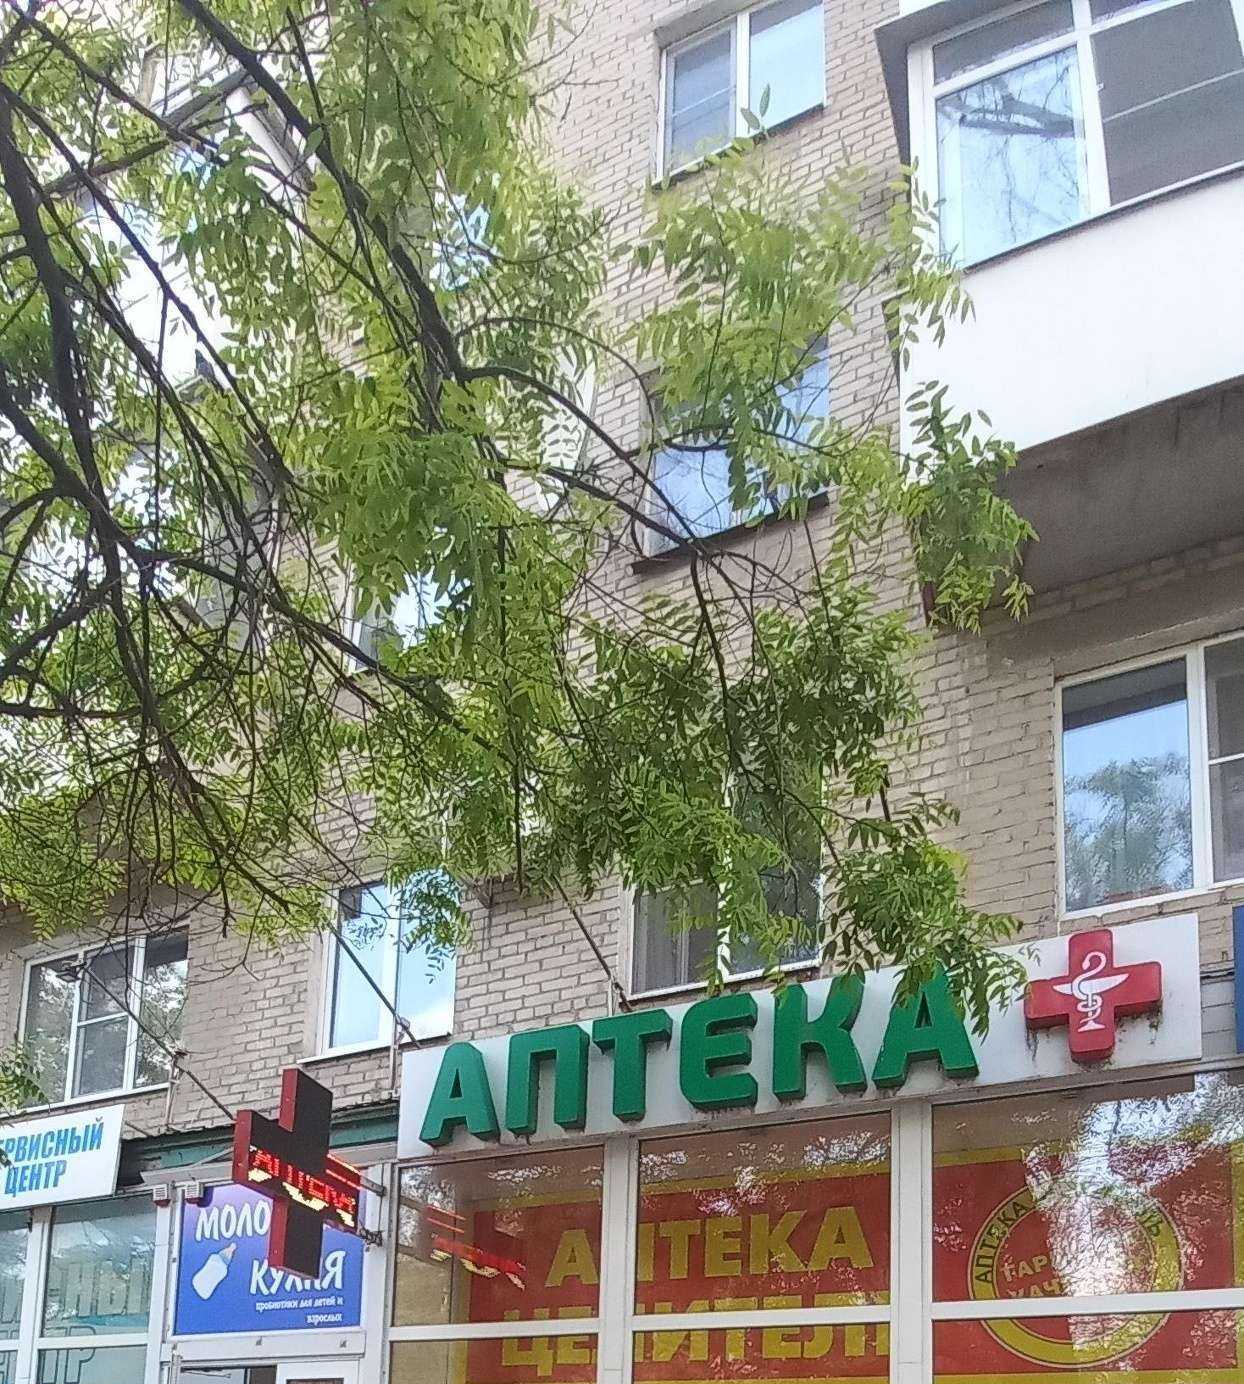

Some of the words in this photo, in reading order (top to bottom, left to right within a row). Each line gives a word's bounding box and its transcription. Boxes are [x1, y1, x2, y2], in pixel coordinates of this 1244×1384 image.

[419, 966, 980, 1147] АПТЕКА
[0, 1116, 104, 1162] РВИСНЫЙ
[5, 1160, 67, 1198] ЦЕНТР
